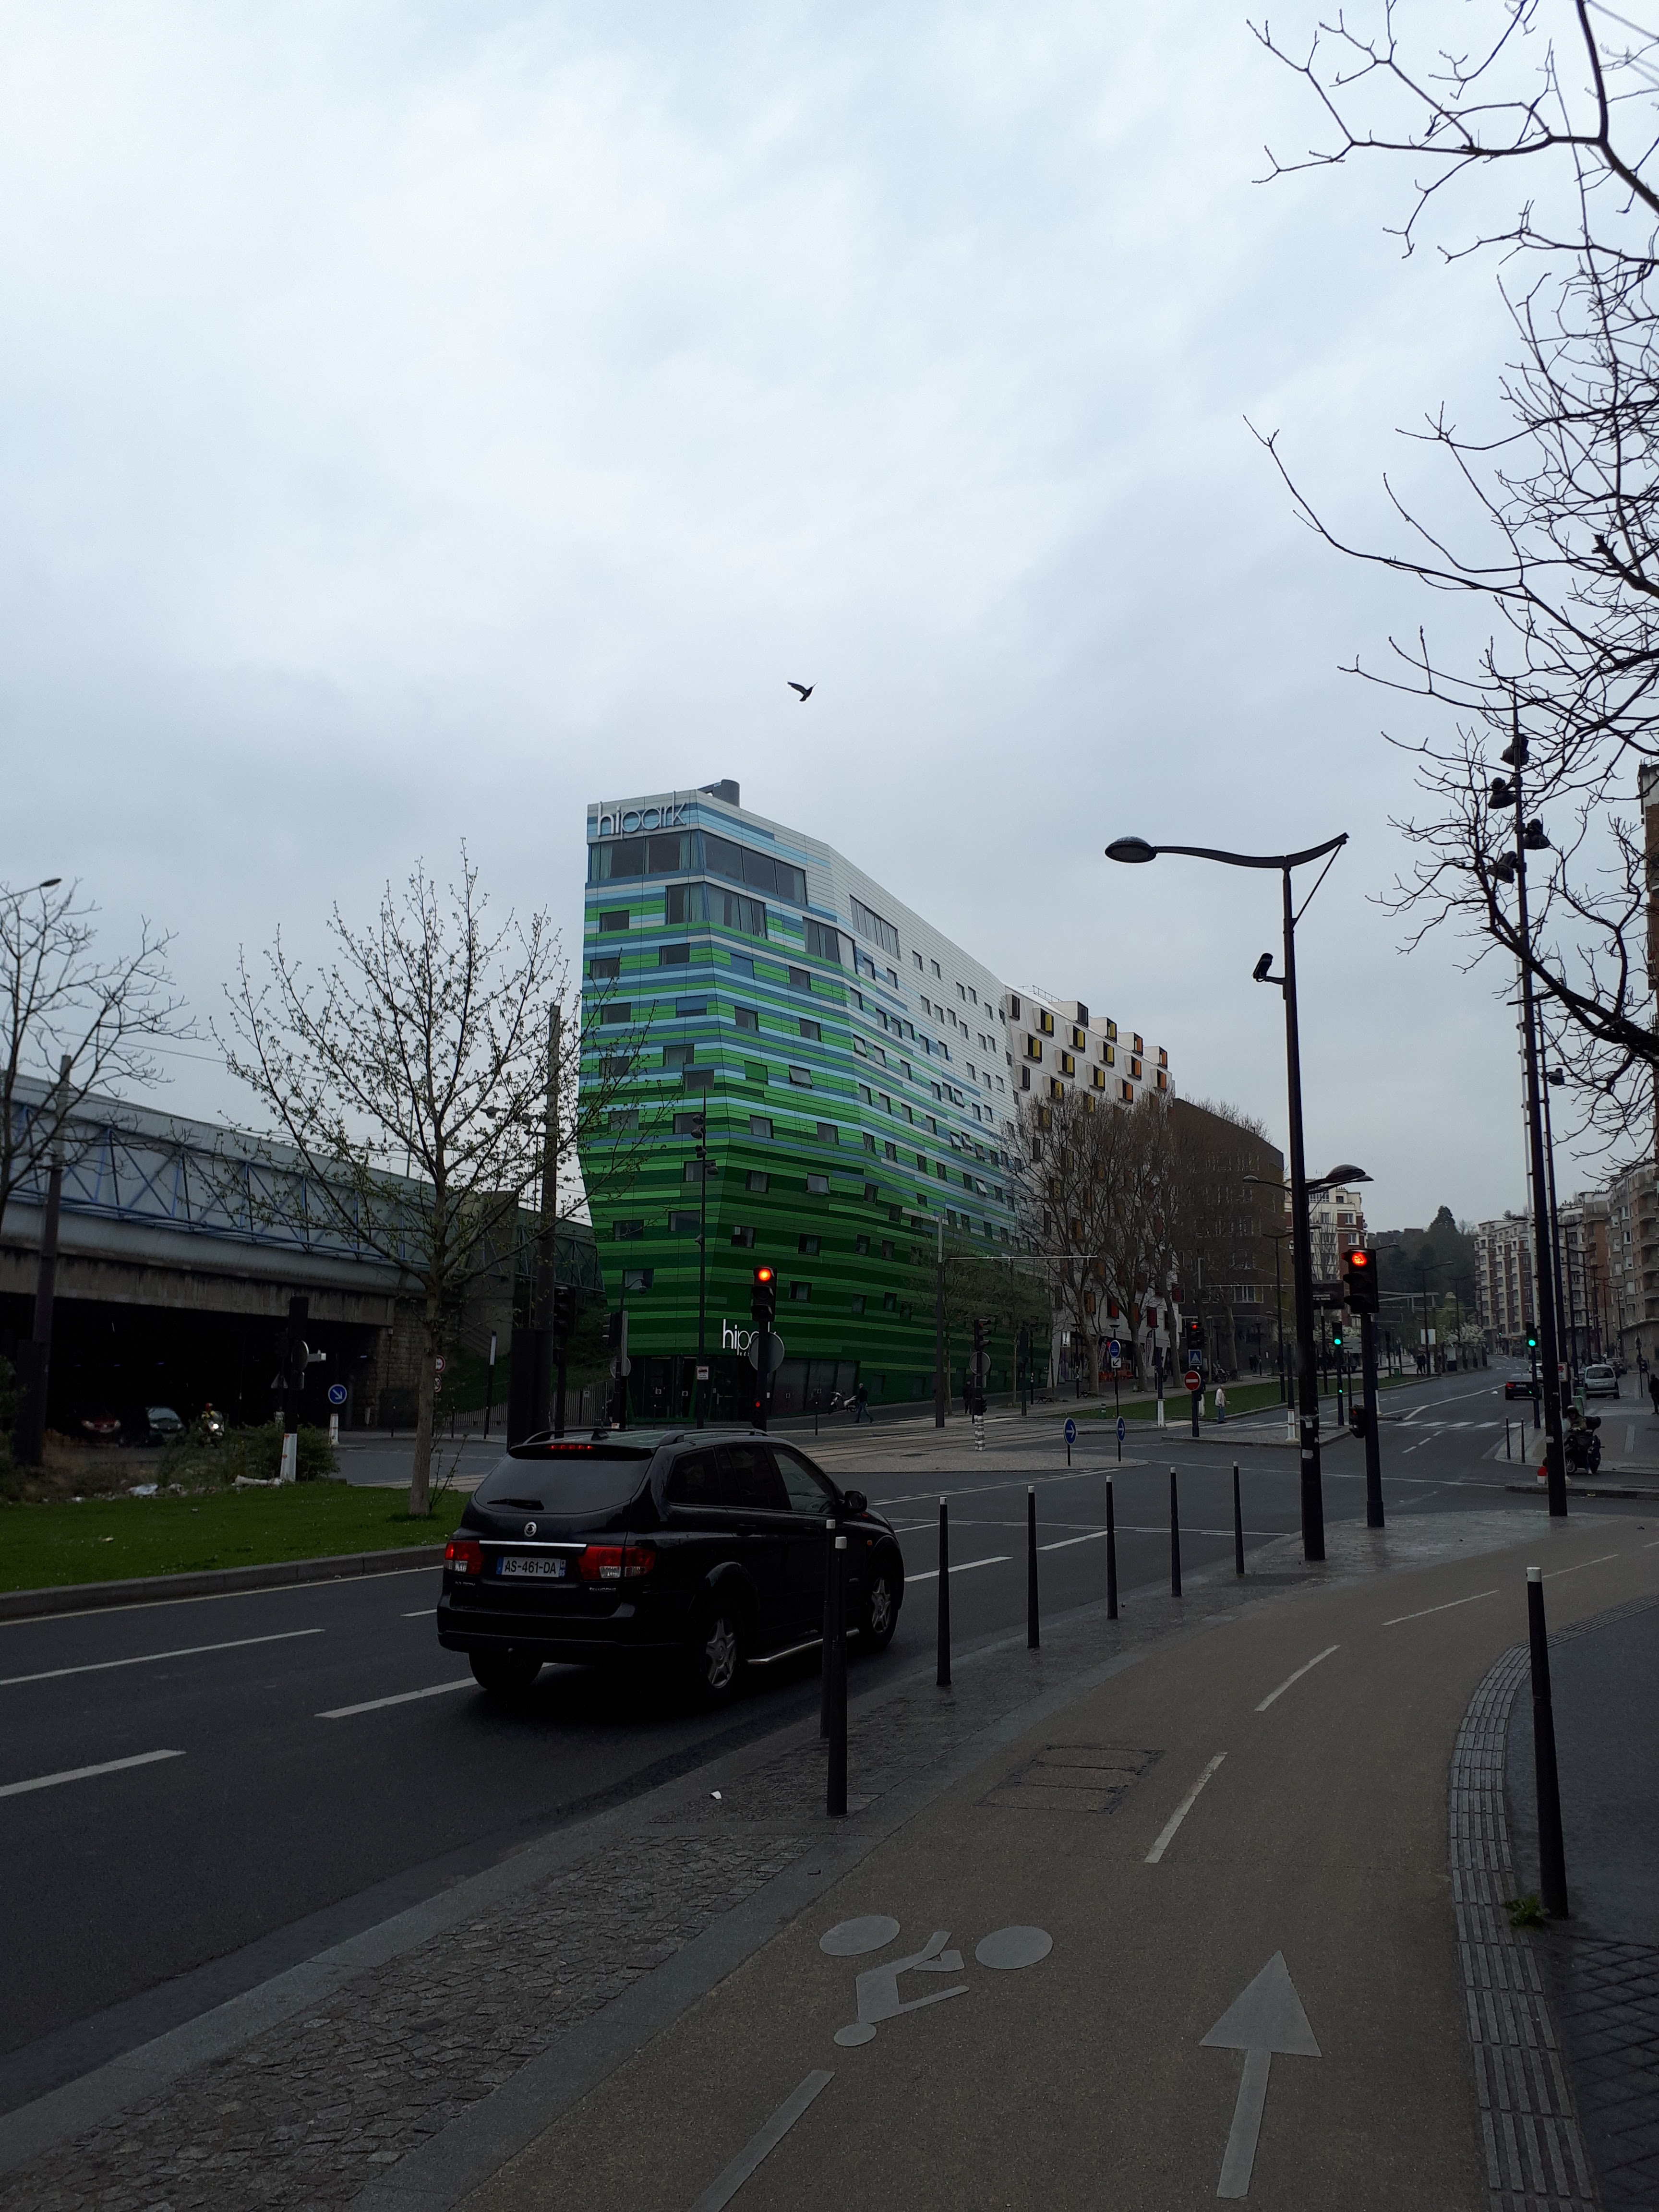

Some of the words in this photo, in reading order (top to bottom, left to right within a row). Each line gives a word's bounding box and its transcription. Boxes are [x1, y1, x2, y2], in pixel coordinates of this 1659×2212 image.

[597, 791, 686, 840] hipark
[722, 1318, 777, 1356] hip
[505, 1560, 556, 1574] AS-461-DA
